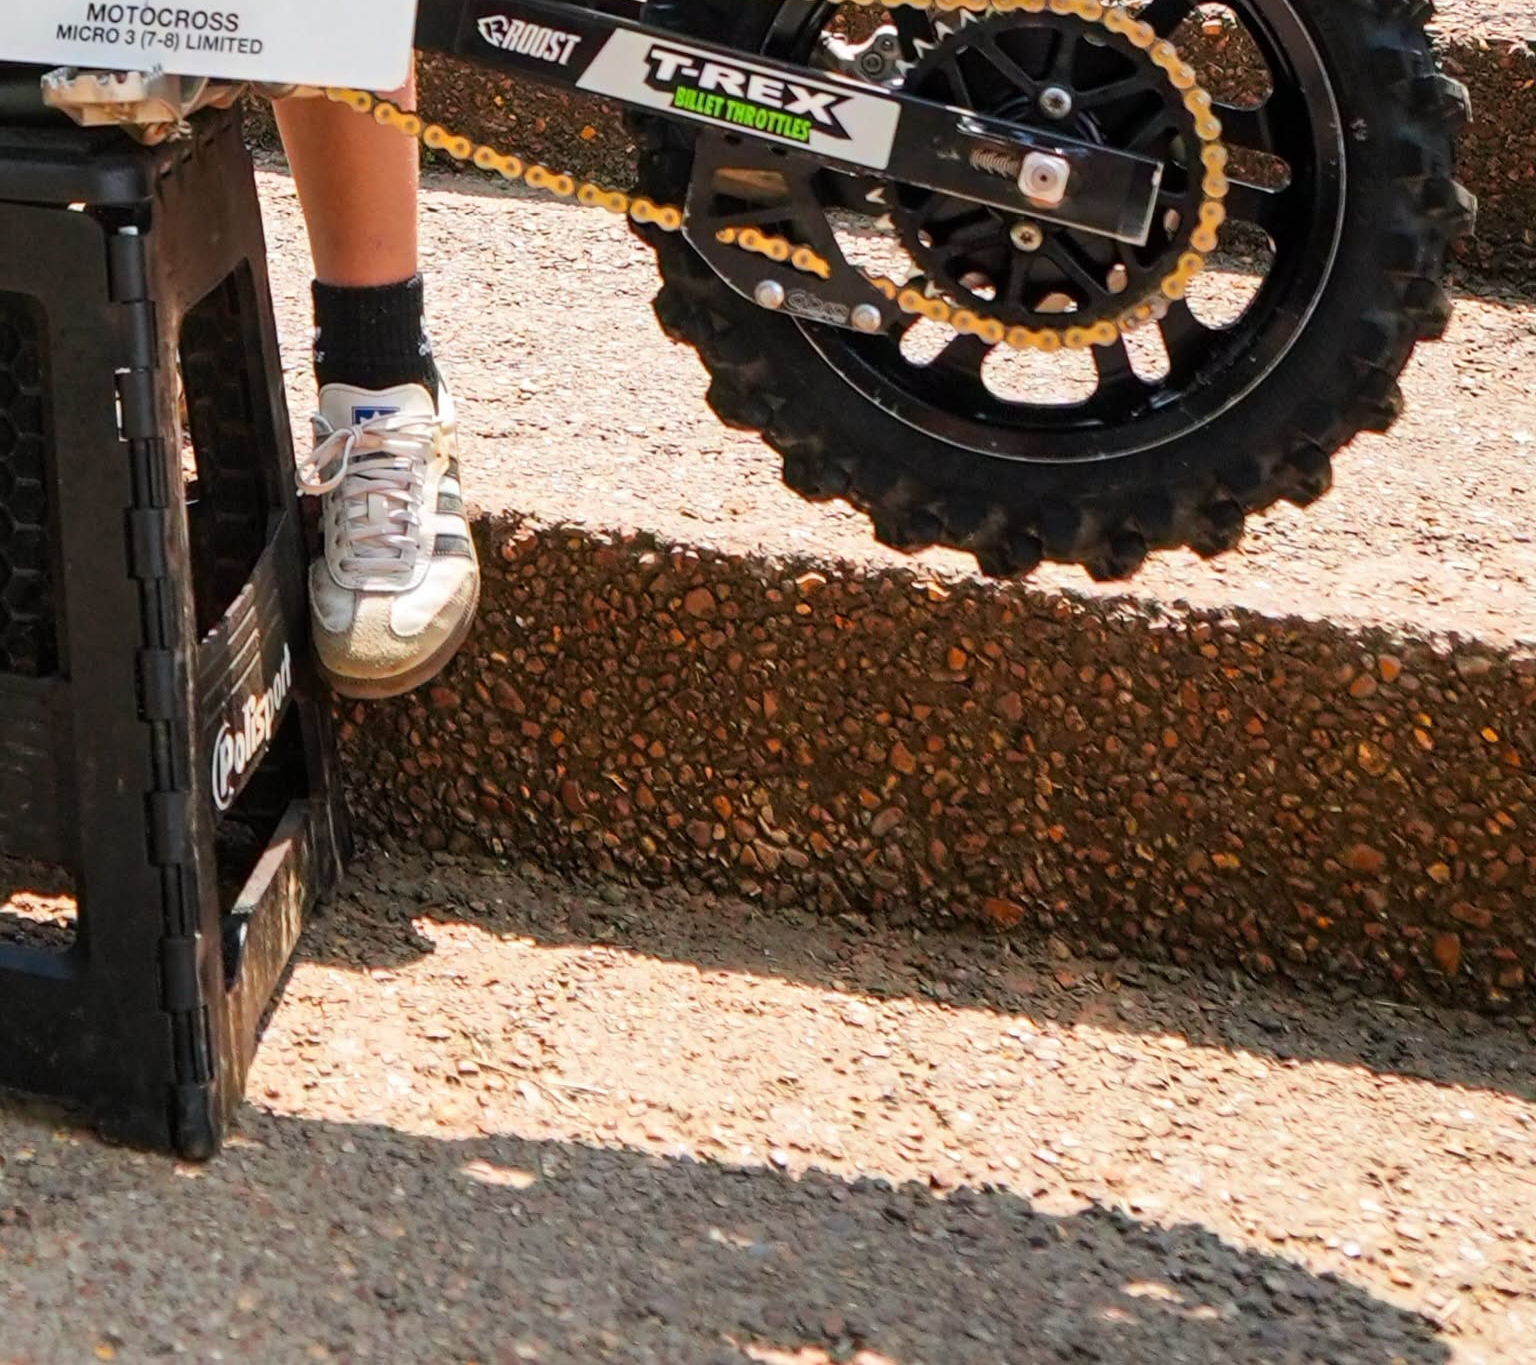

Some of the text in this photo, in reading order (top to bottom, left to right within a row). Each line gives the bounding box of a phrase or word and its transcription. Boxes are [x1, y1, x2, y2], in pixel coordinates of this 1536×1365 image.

[55, 24, 264, 56] MICRO 3 (7-8) LIMITED
[86, 2, 240, 33] MOTOCROSS
[501, 20, 582, 67] ROOST
[649, 48, 840, 126] T-REX
[673, 86, 813, 142] BILLET THROTTLES
[212, 641, 292, 811] Polisport
